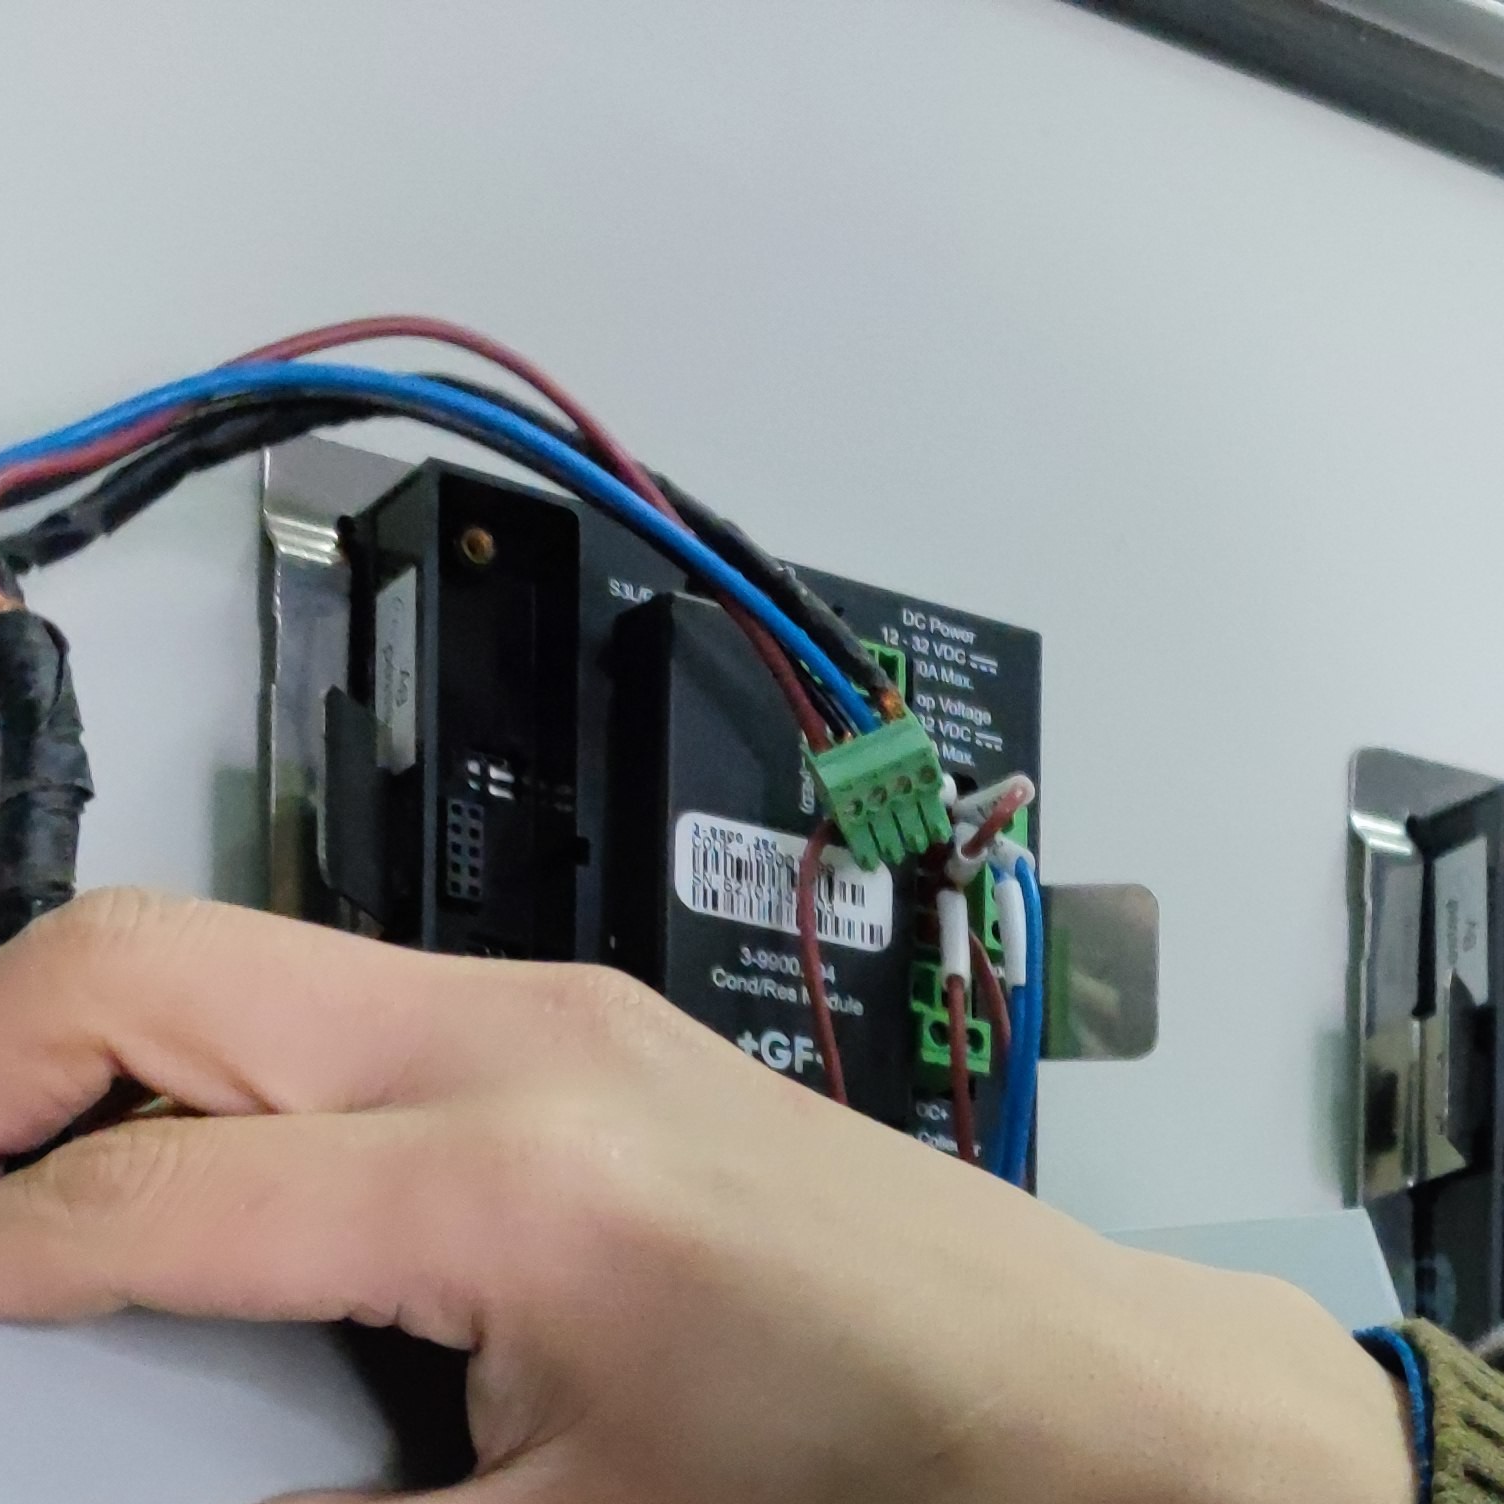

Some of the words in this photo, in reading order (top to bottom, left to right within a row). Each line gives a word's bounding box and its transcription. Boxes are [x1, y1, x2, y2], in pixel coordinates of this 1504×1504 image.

[902, 608, 927, 631] DC
[930, 615, 977, 645] Power
[881, 625, 900, 647] 12
[911, 634, 930, 656] 32
[932, 641, 967, 666] VDC
[940, 665, 975, 691] Max.
[938, 694, 993, 728] Voltage
[938, 718, 972, 743] VDC
[739, 944, 837, 986] 3-9900.4
[711, 966, 798, 1003] Cond/Res
[802, 990, 866, 1018] Mdule
